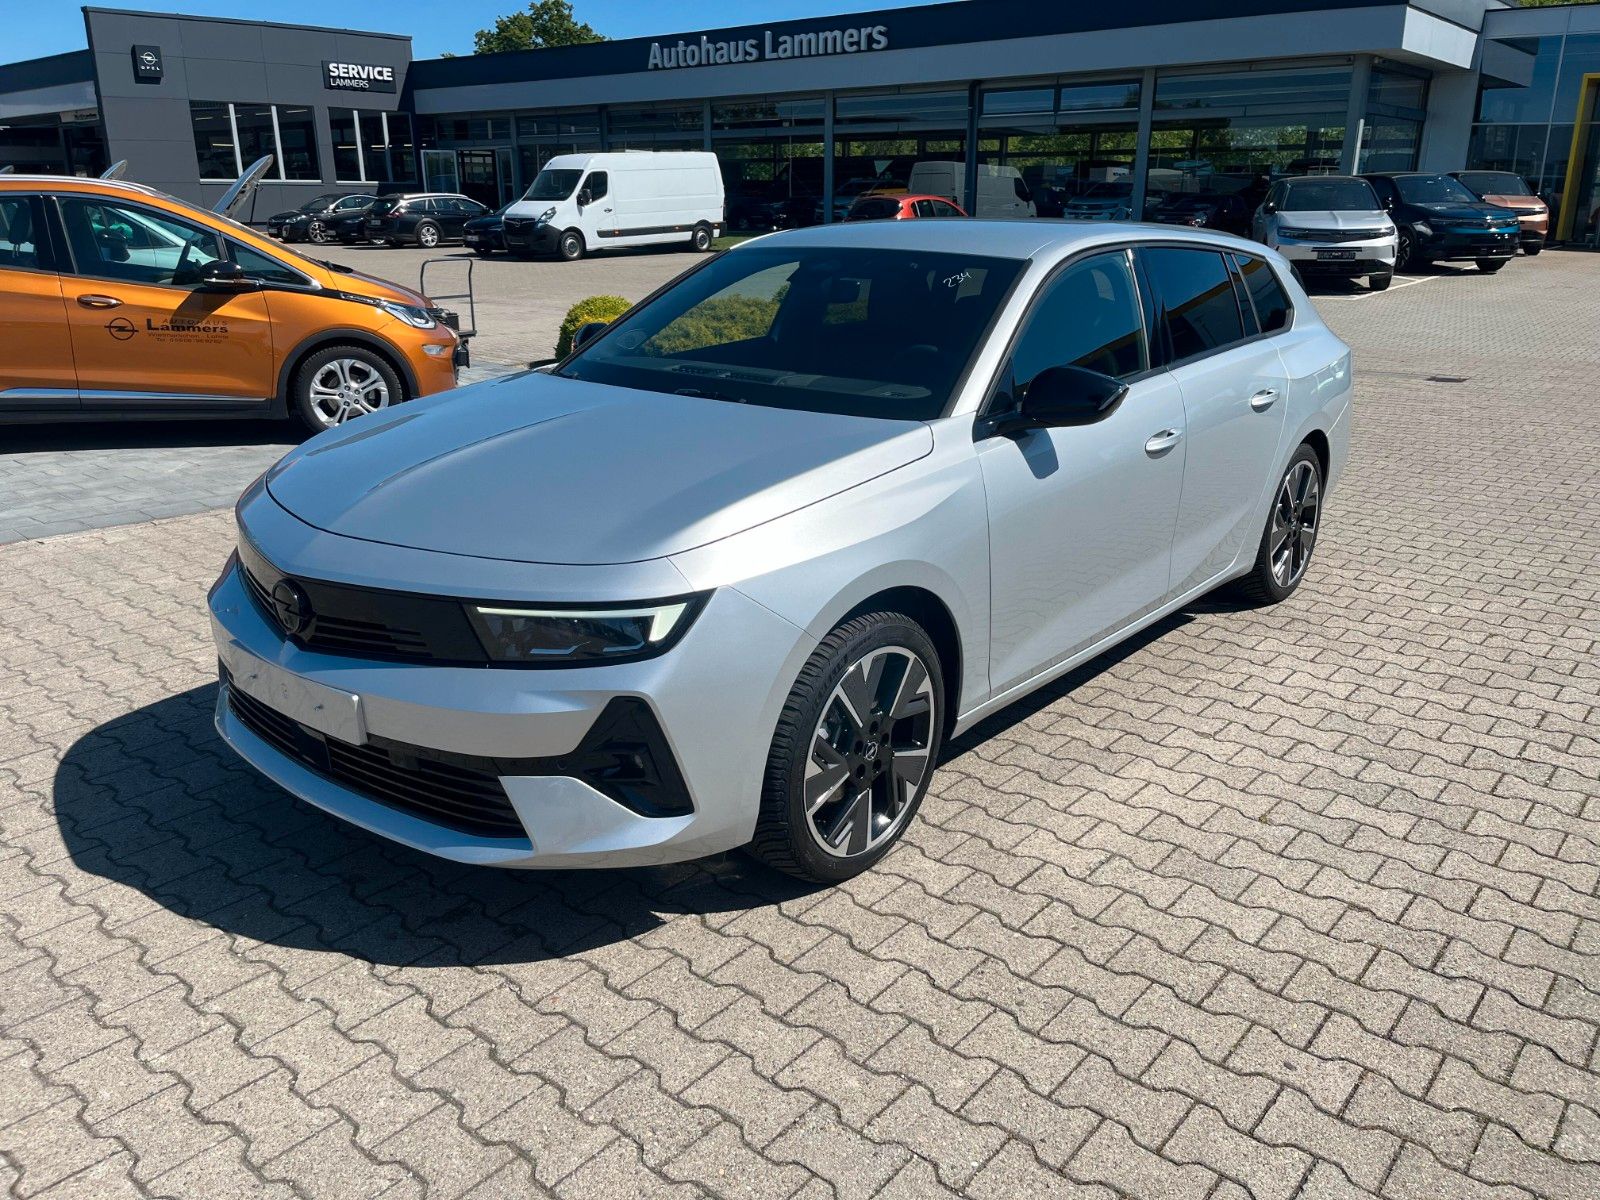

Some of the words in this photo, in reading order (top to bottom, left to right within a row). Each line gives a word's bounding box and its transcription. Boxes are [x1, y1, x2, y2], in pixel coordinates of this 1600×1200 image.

[648, 35, 760, 70] Autohaus
[764, 25, 888, 59] Lammers
[328, 62, 393, 81] SERVICE
[330, 78, 370, 89] LAMMERS
[943, 271, 972, 288] 234
[146, 318, 229, 333] Lammers
[162, 318, 228, 326] AUTOHAUS
